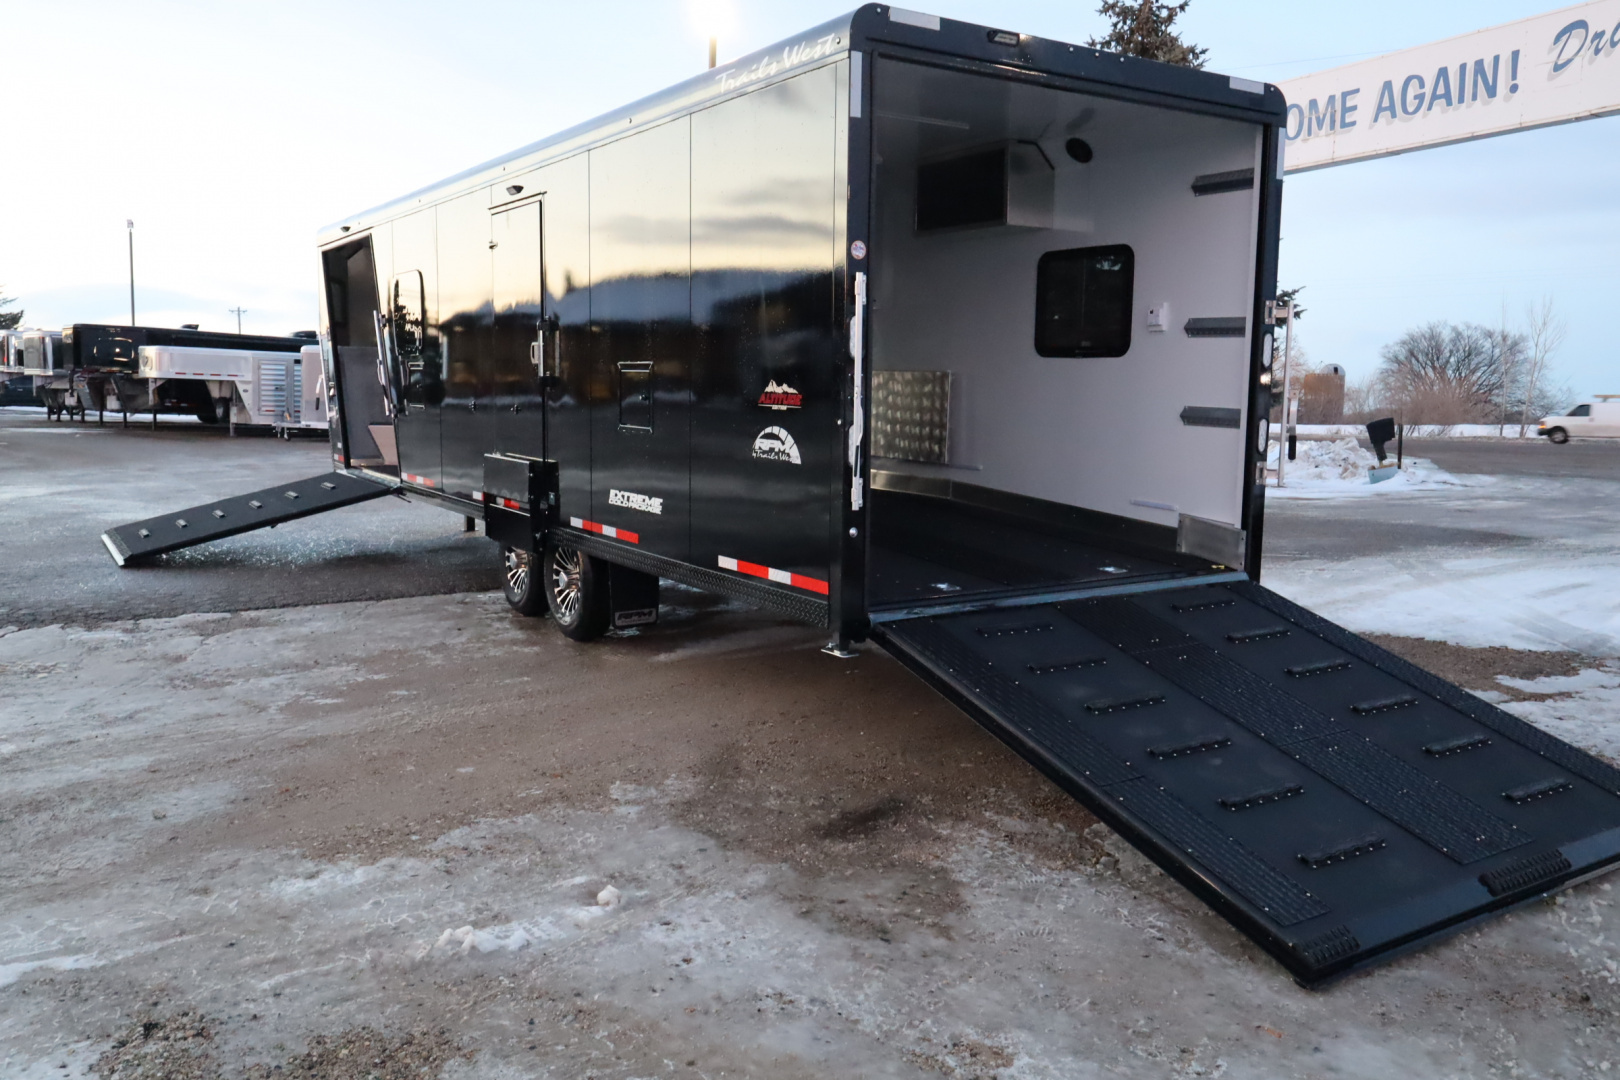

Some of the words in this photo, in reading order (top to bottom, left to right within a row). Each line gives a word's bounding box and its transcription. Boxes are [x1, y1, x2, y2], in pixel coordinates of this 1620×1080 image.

[716, 56, 778, 93] Trails
[783, 33, 835, 68] West
[1285, 87, 1360, 141] OME
[1373, 49, 1520, 123] AGAIN!
[608, 498, 629, 507] COLD
[628, 502, 662, 515] PACKAGE
[609, 489, 663, 507] EXTREME
